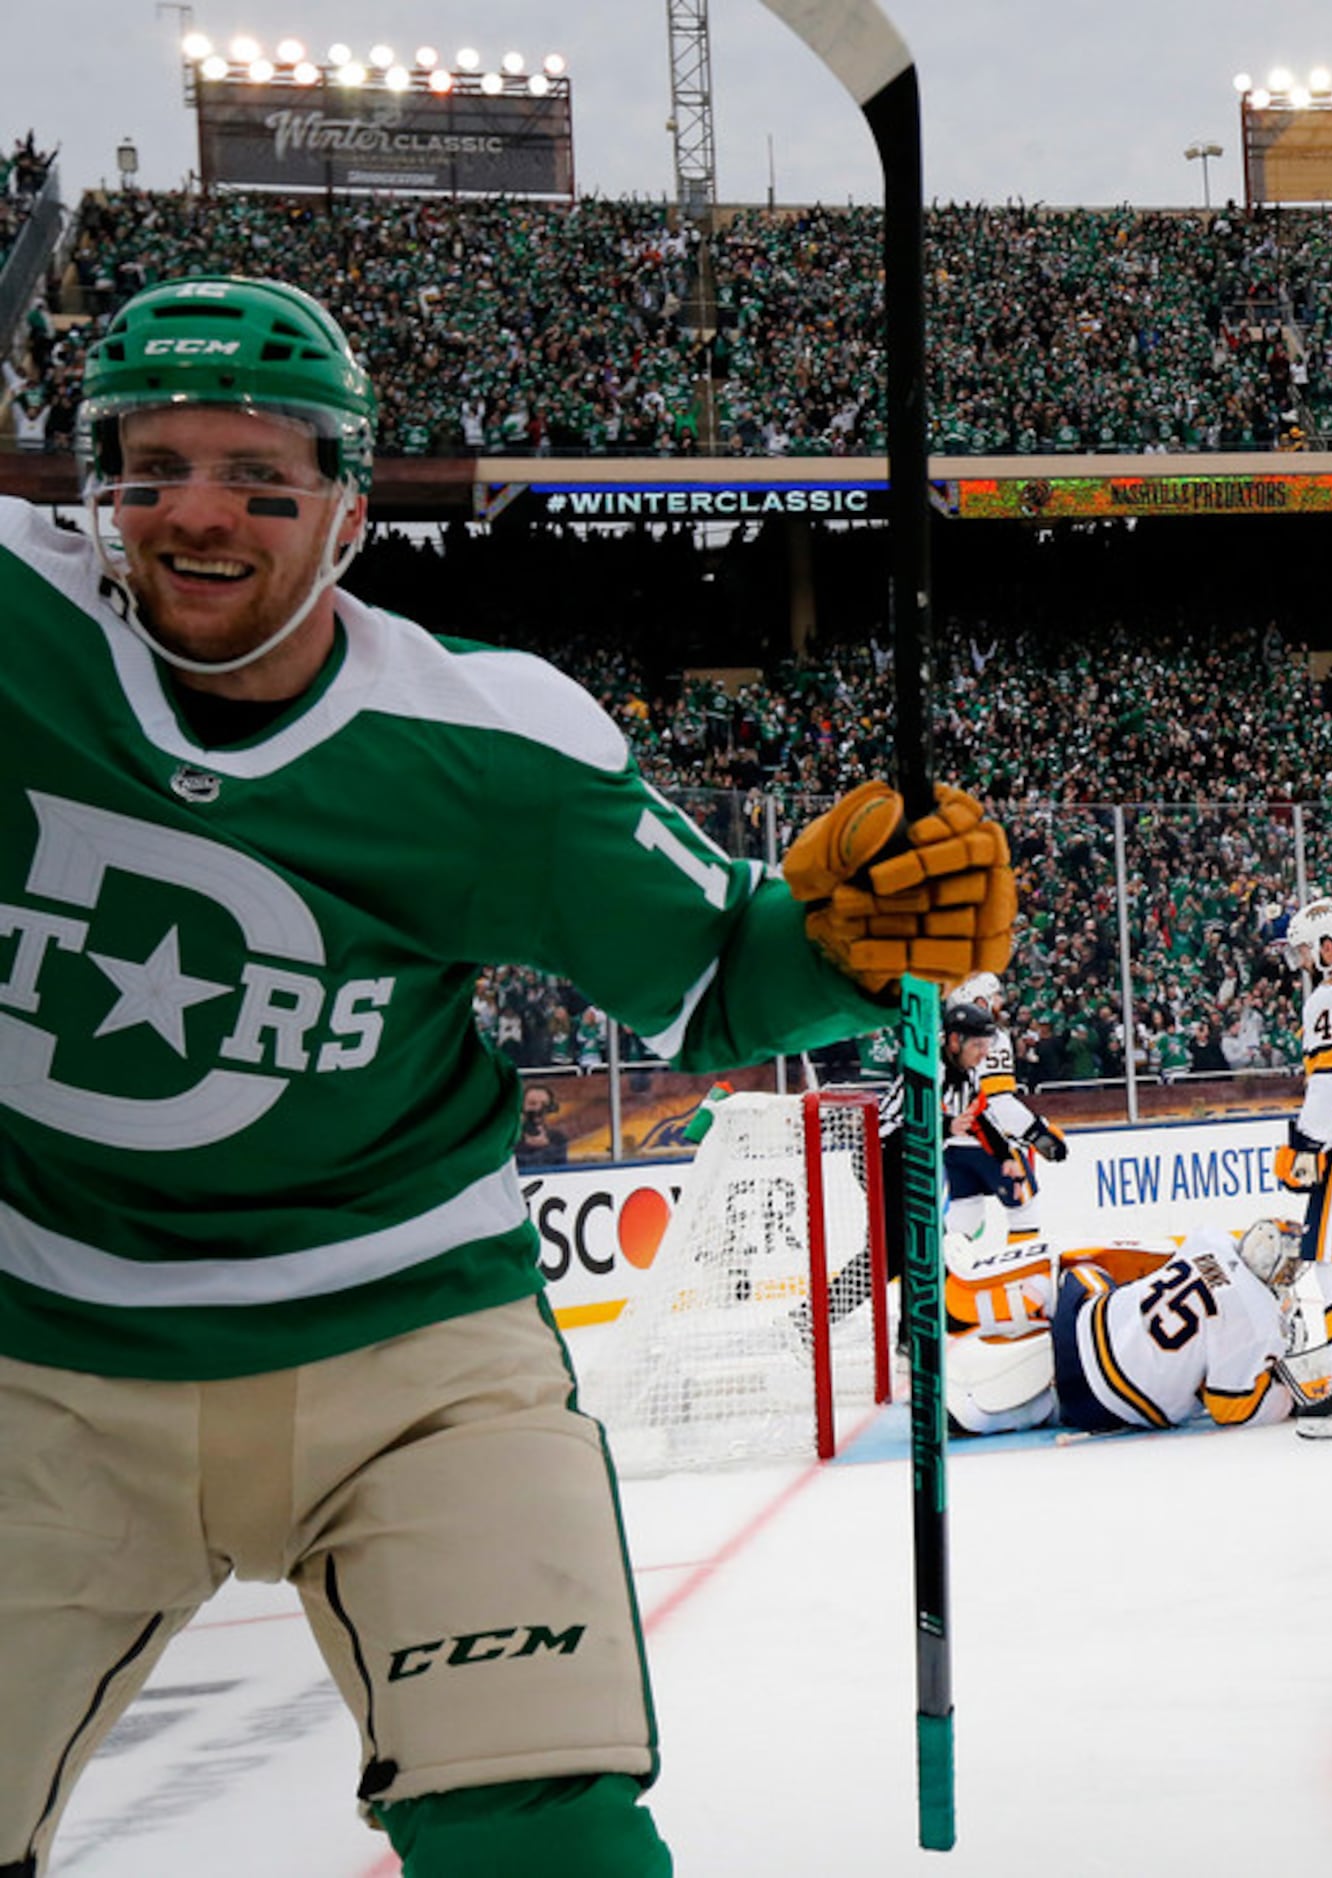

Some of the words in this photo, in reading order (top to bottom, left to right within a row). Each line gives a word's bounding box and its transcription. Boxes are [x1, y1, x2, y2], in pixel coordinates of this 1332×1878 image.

[265, 109, 394, 161] Winter
[393, 135, 503, 153] CLASSIC
[143, 339, 241, 355] CCM
[546, 489, 869, 515] #WINTERCLASSIC
[1110, 483, 1190, 505] NASHVILLE
[1193, 481, 1287, 509] PREDATORS
[985, 1049, 1012, 1070] 52
[1096, 1153, 1161, 1208] NEW
[1171, 1145, 1285, 1201] AMSTE
[971, 1243, 1049, 1270] CCM
[1139, 1257, 1219, 1352] 35
[387, 1623, 587, 1683] CCM
